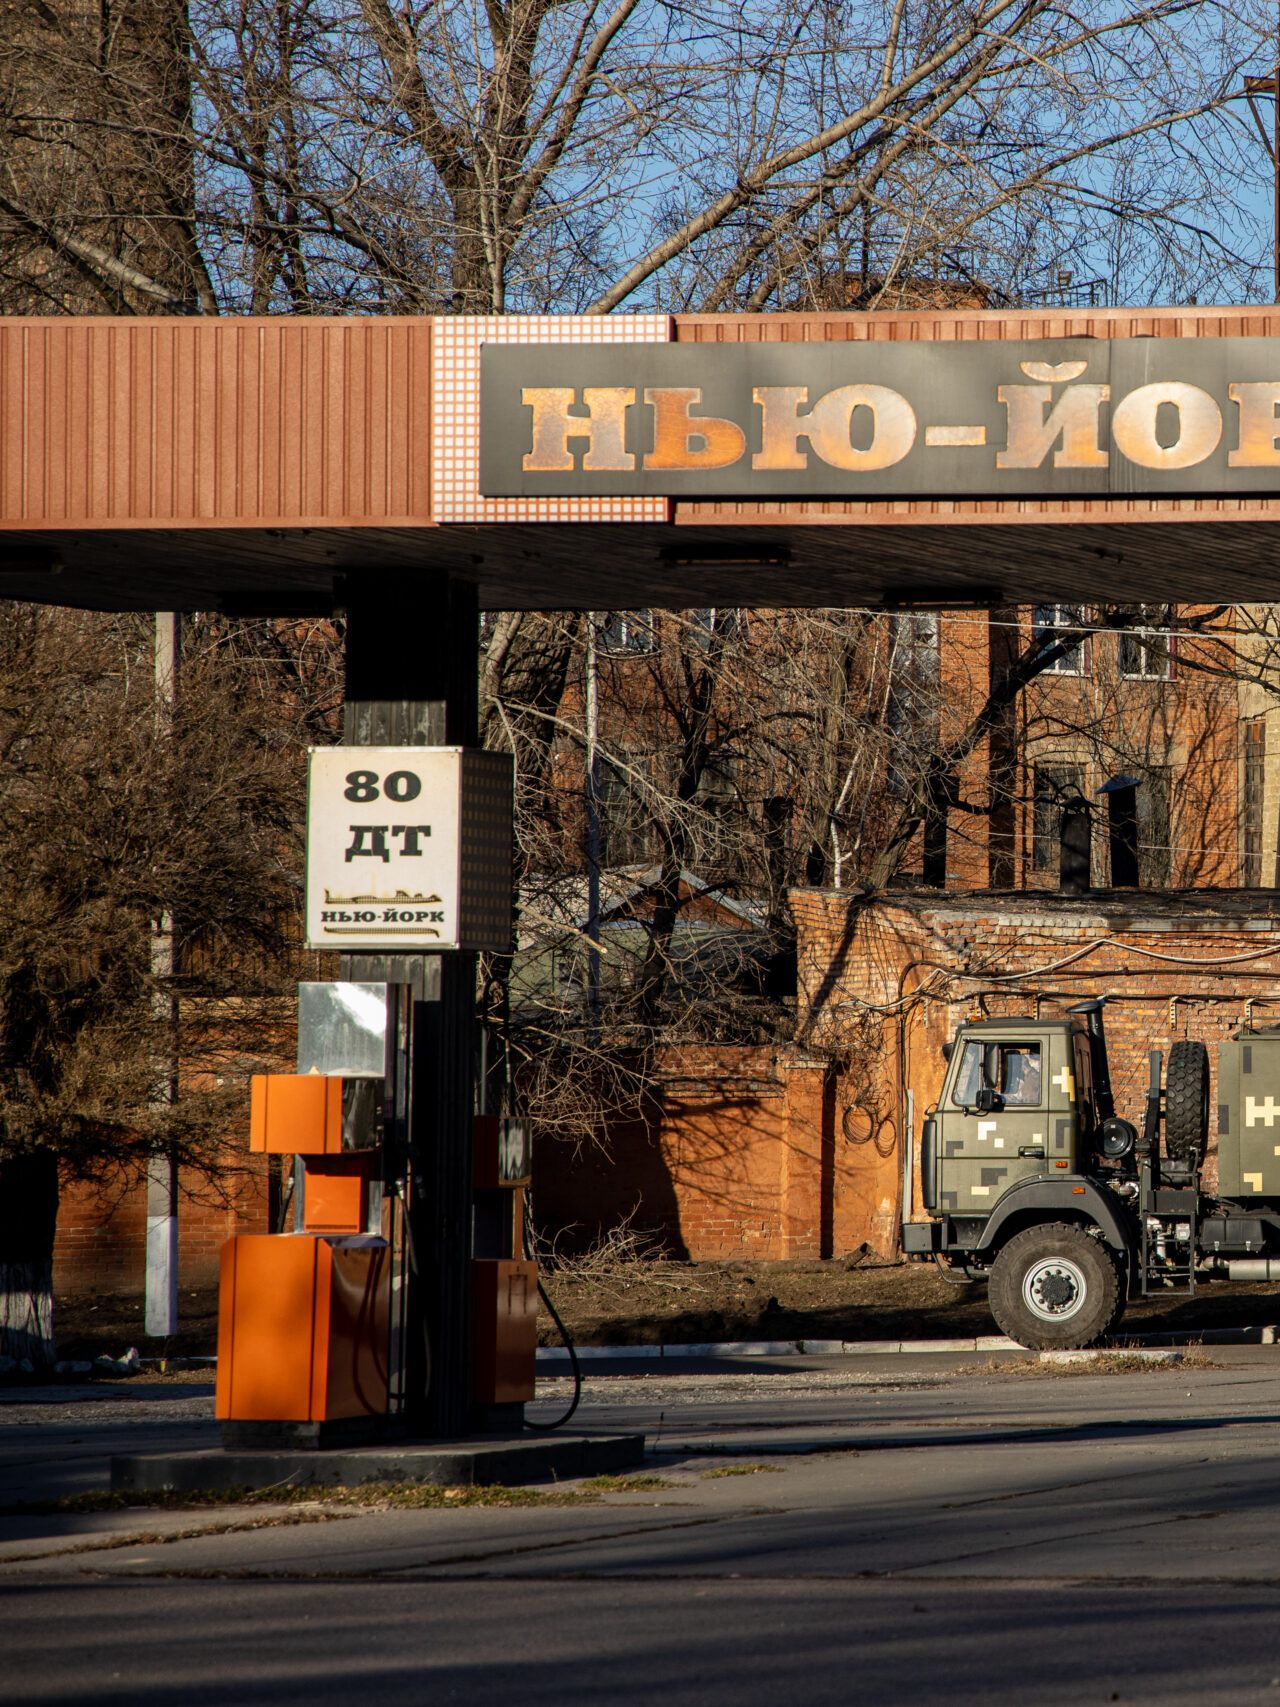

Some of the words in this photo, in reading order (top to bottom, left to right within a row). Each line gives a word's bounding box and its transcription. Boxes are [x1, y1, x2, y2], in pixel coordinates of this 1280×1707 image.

[343, 769, 422, 803] 80
[344, 824, 432, 863] ДТ
[320, 908, 445, 923] НЬЮ-ЙОРК
